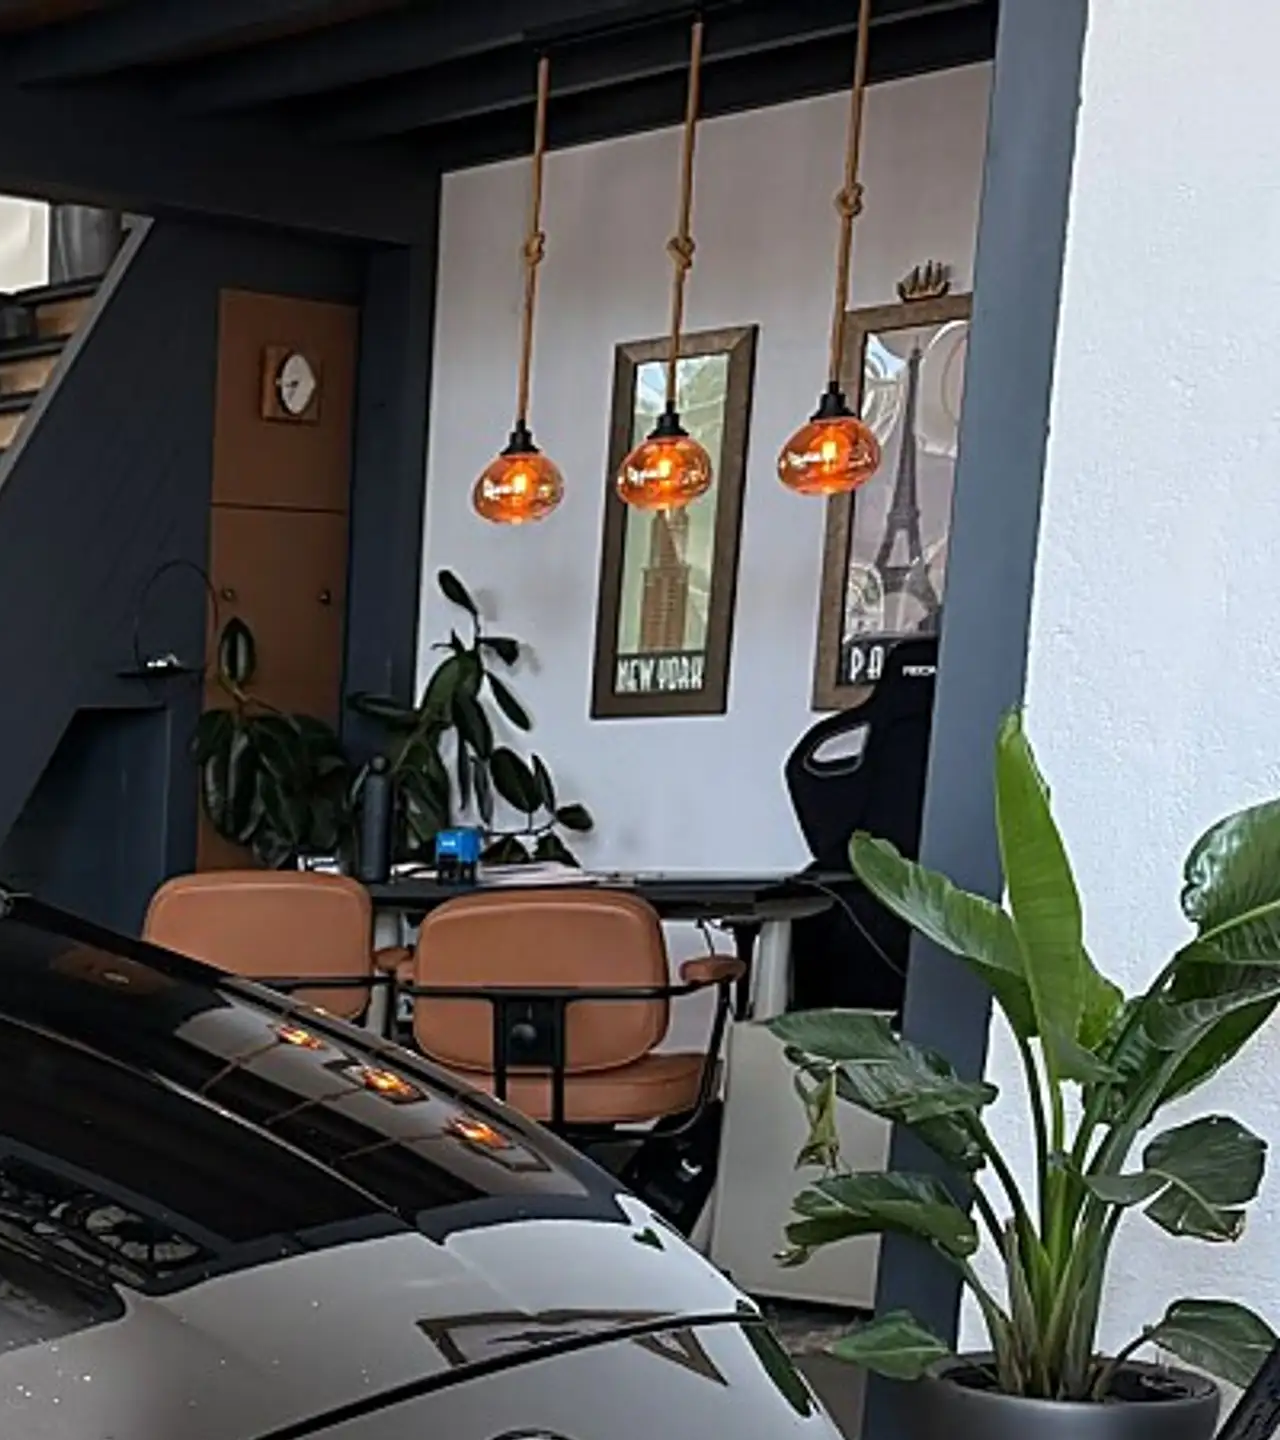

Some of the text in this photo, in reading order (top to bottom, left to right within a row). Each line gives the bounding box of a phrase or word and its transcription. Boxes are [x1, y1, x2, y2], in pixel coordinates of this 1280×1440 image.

[615, 656, 705, 693] NEW YORK
[849, 646, 885, 682] PA
